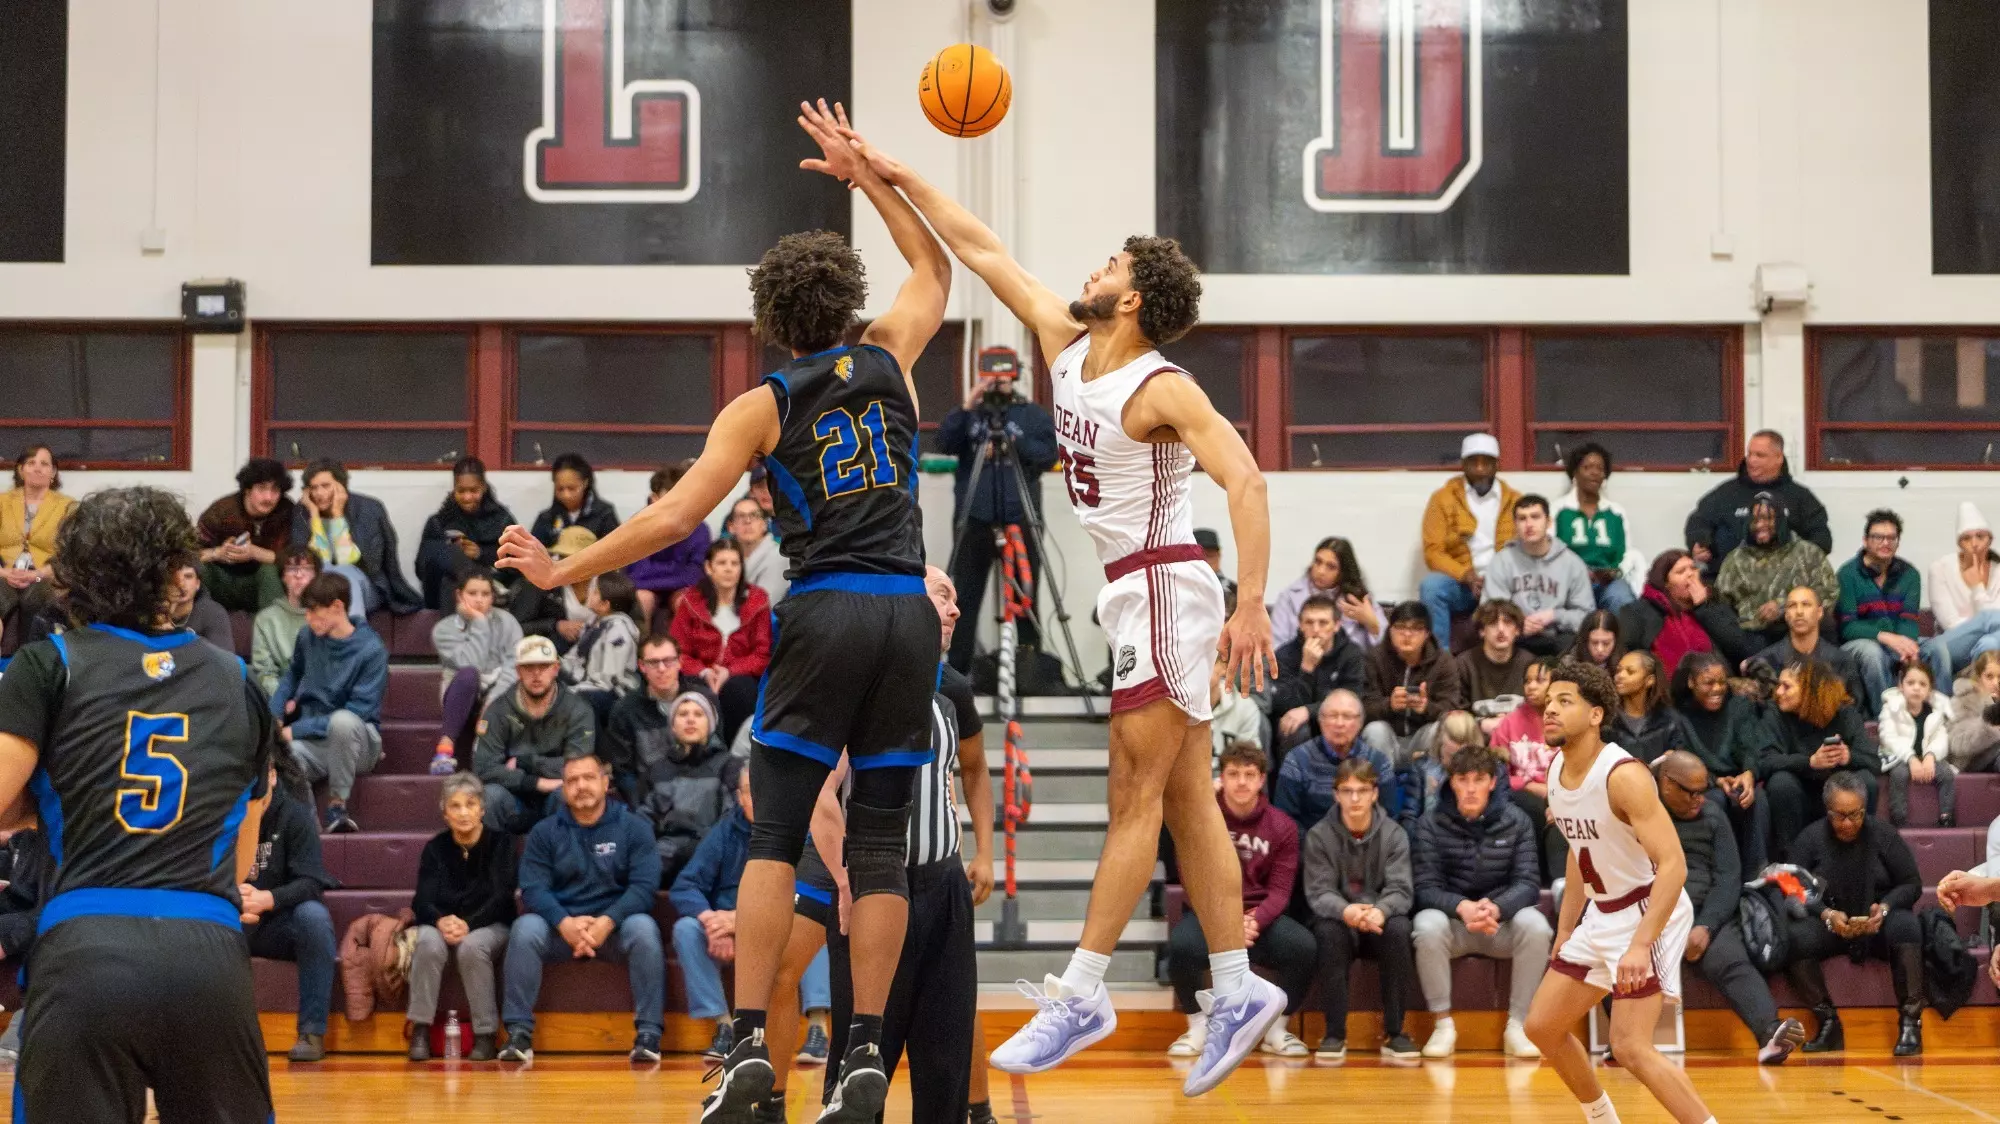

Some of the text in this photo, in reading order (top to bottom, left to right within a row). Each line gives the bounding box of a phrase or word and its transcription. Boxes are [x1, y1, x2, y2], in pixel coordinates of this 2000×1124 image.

[812, 400, 898, 501] 21
[1054, 403, 1100, 450] DEAN
[1570, 516, 1612, 546] 11
[114, 710, 189, 834] 5
[1578, 846, 1608, 895] 4
